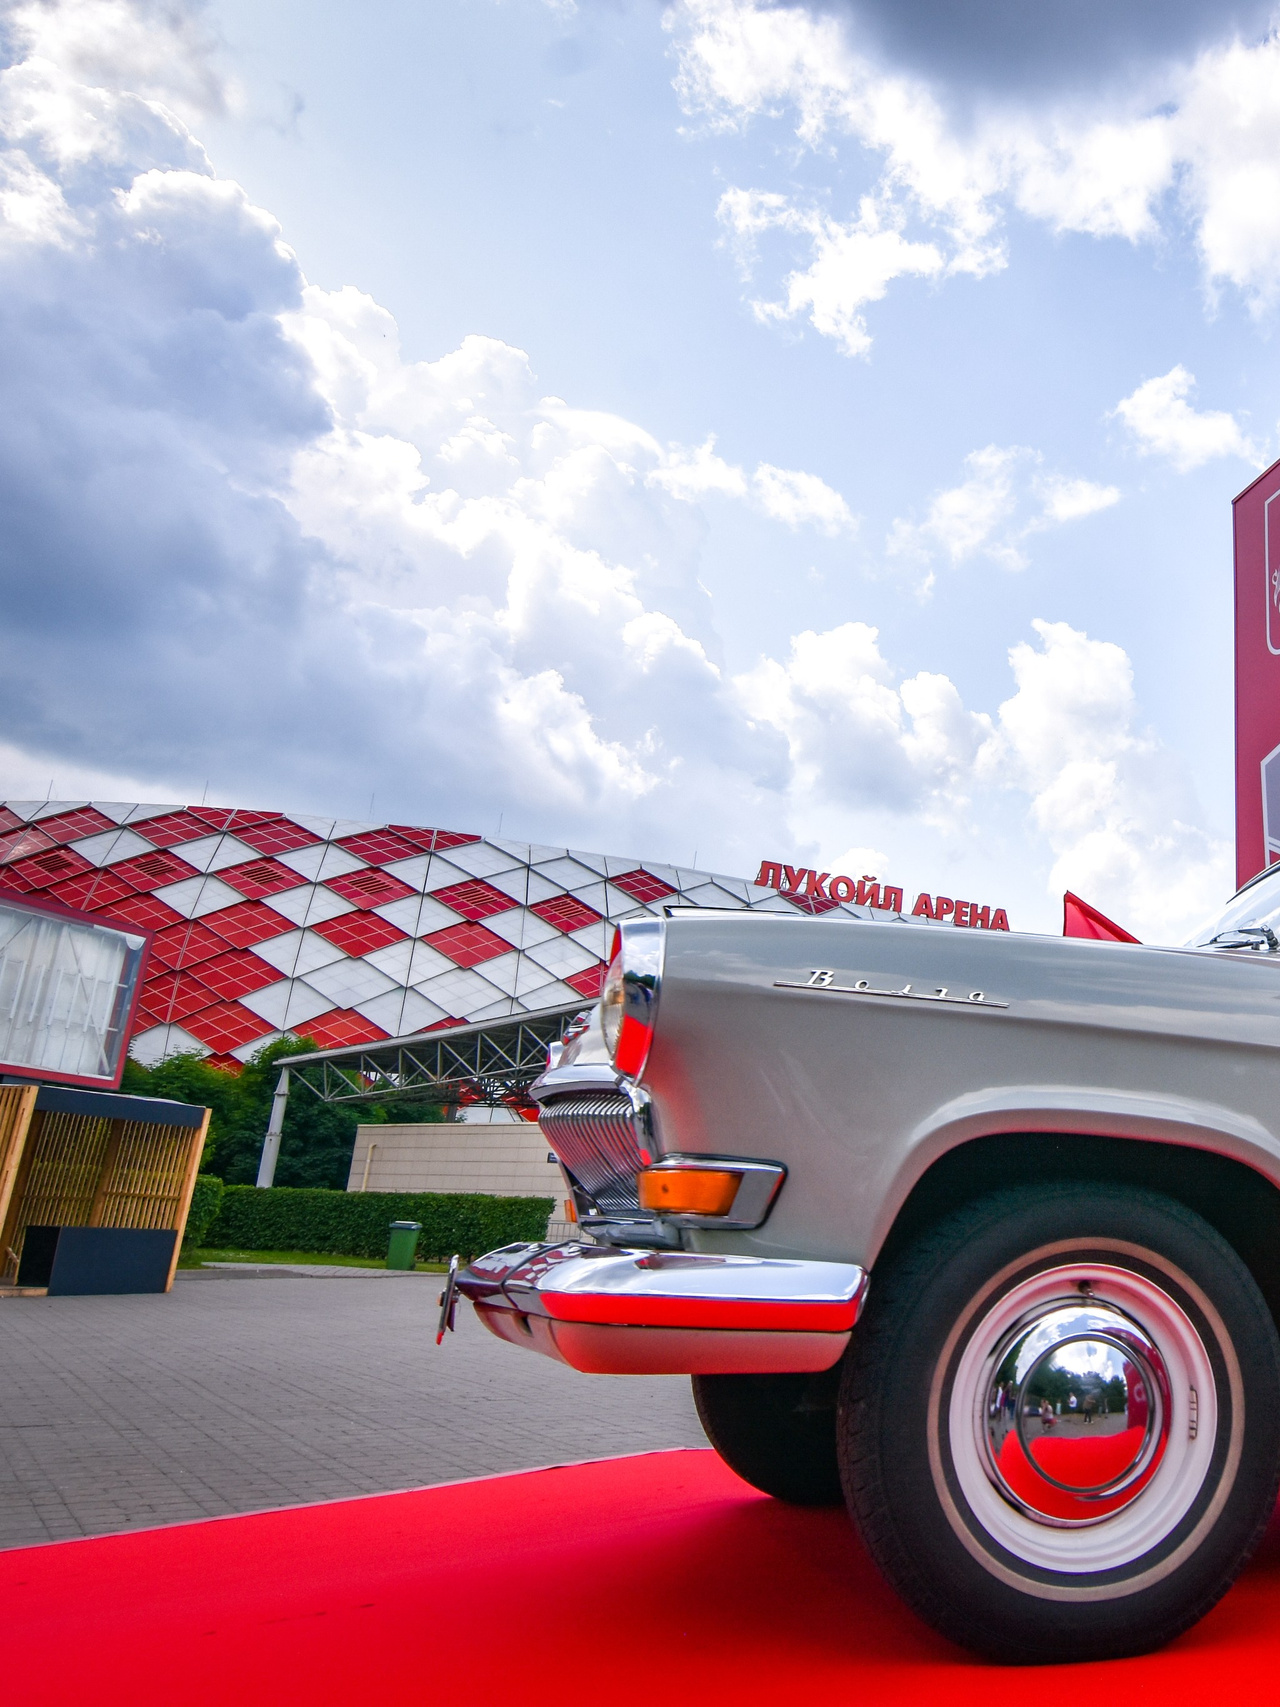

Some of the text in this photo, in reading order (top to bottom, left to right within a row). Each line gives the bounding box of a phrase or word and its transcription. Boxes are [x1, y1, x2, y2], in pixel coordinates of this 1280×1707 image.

[754, 860, 1010, 932] ЛУКОЙЛ АРЕНА
[806, 969, 985, 1001] Волга
